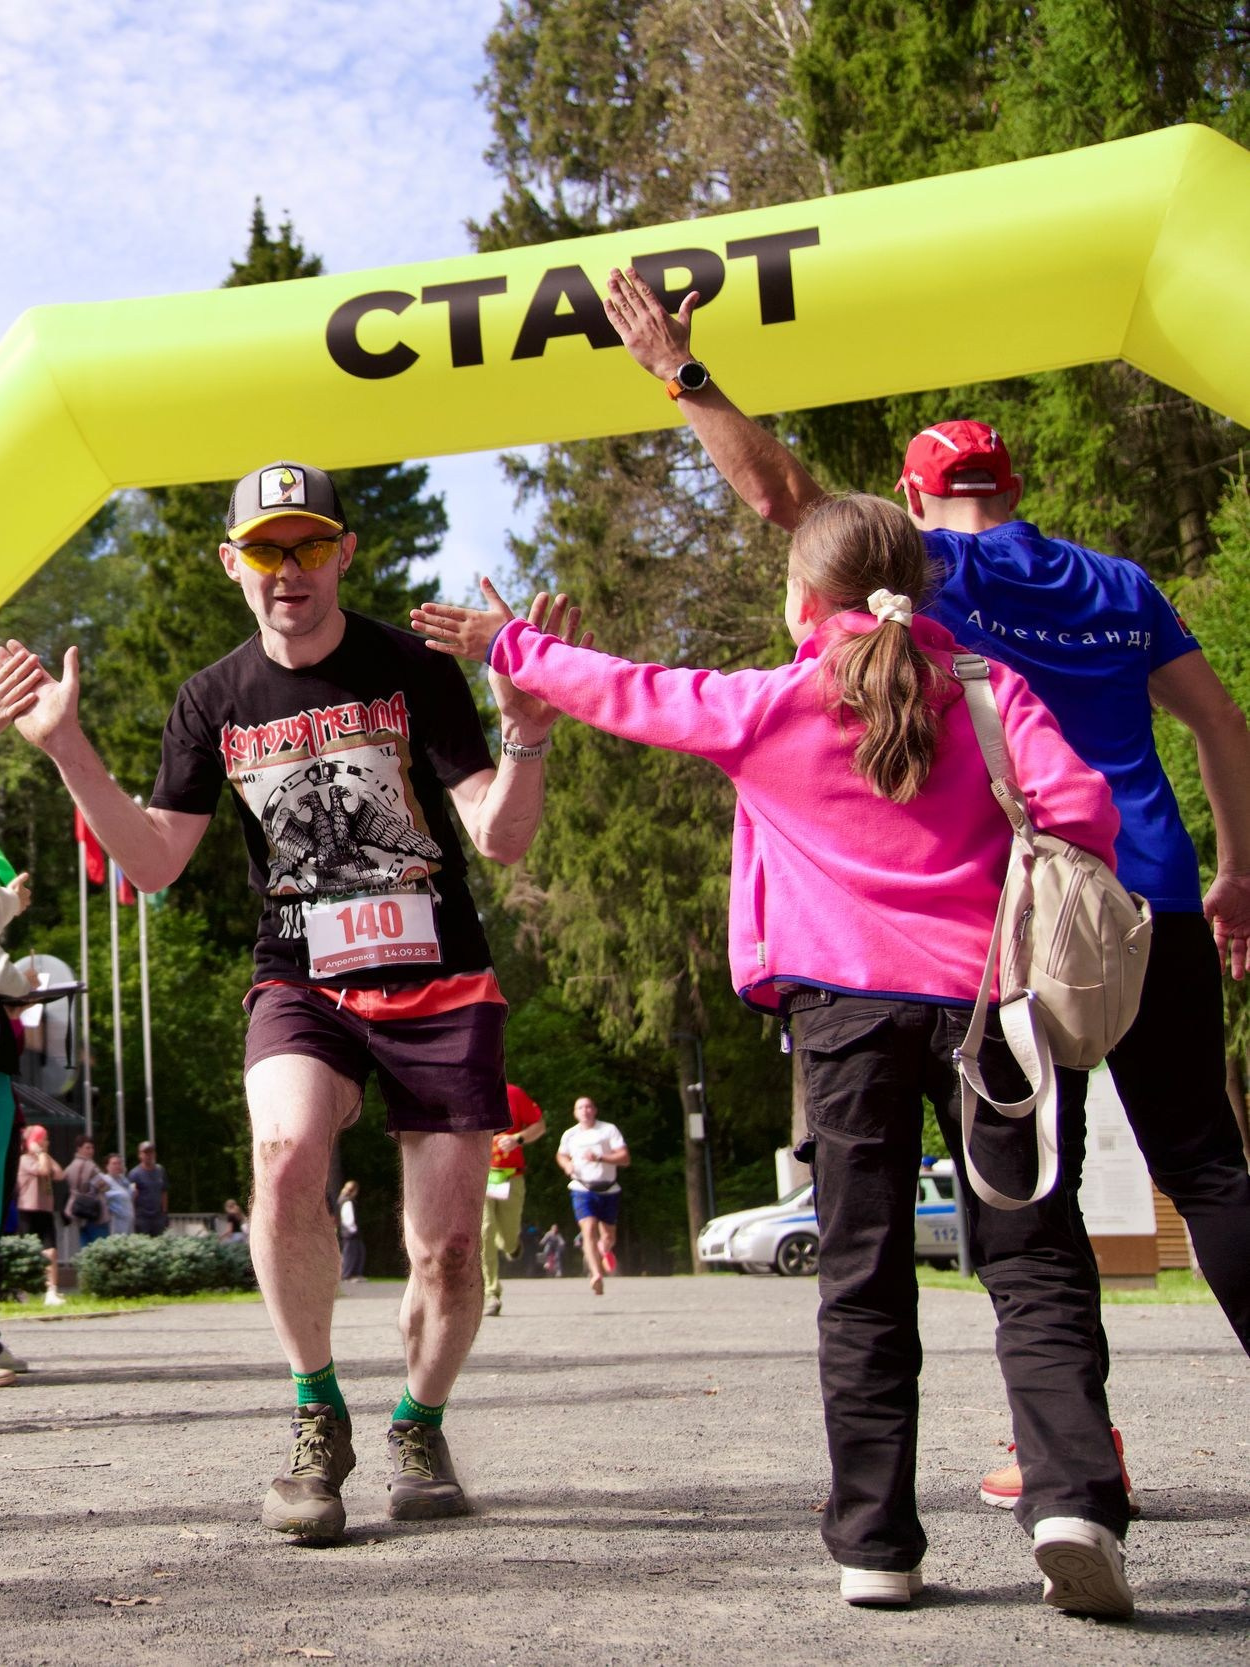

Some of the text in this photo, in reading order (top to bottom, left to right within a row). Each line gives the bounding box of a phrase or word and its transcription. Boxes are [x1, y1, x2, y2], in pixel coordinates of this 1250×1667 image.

[325, 226, 821, 379] СТАРТ
[336, 900, 404, 945] 140
[384, 948, 428, 958] 14.09.25
[934, 1227, 958, 1242] 112
